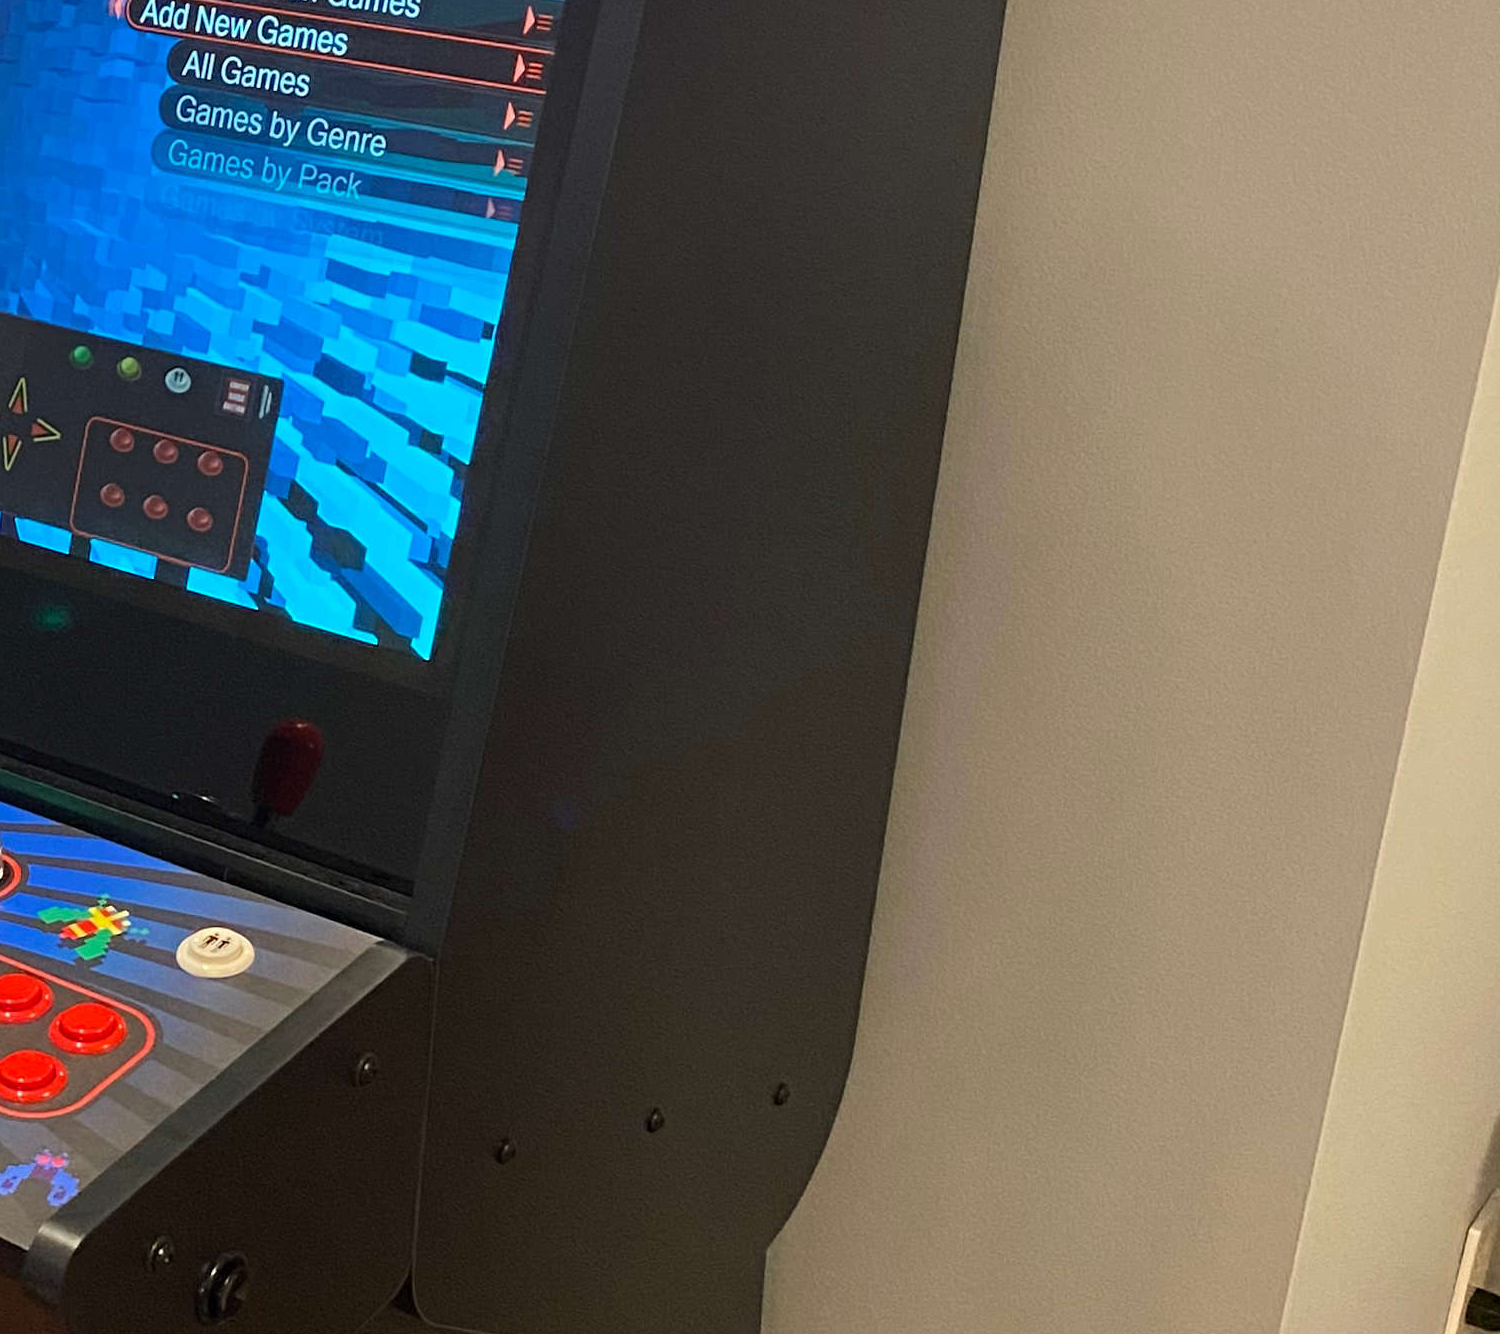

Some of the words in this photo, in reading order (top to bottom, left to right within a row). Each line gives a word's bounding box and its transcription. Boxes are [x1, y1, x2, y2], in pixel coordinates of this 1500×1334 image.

[195, 5, 252, 40] New
[257, 14, 349, 57] Games
[181, 50, 215, 81] All
[221, 55, 311, 97] Games
[175, 94, 263, 136] Games
[269, 111, 301, 147] by
[306, 117, 387, 157] Genre
[168, 138, 254, 180] Games
[260, 156, 291, 192] by
[298, 162, 362, 200] Pack
